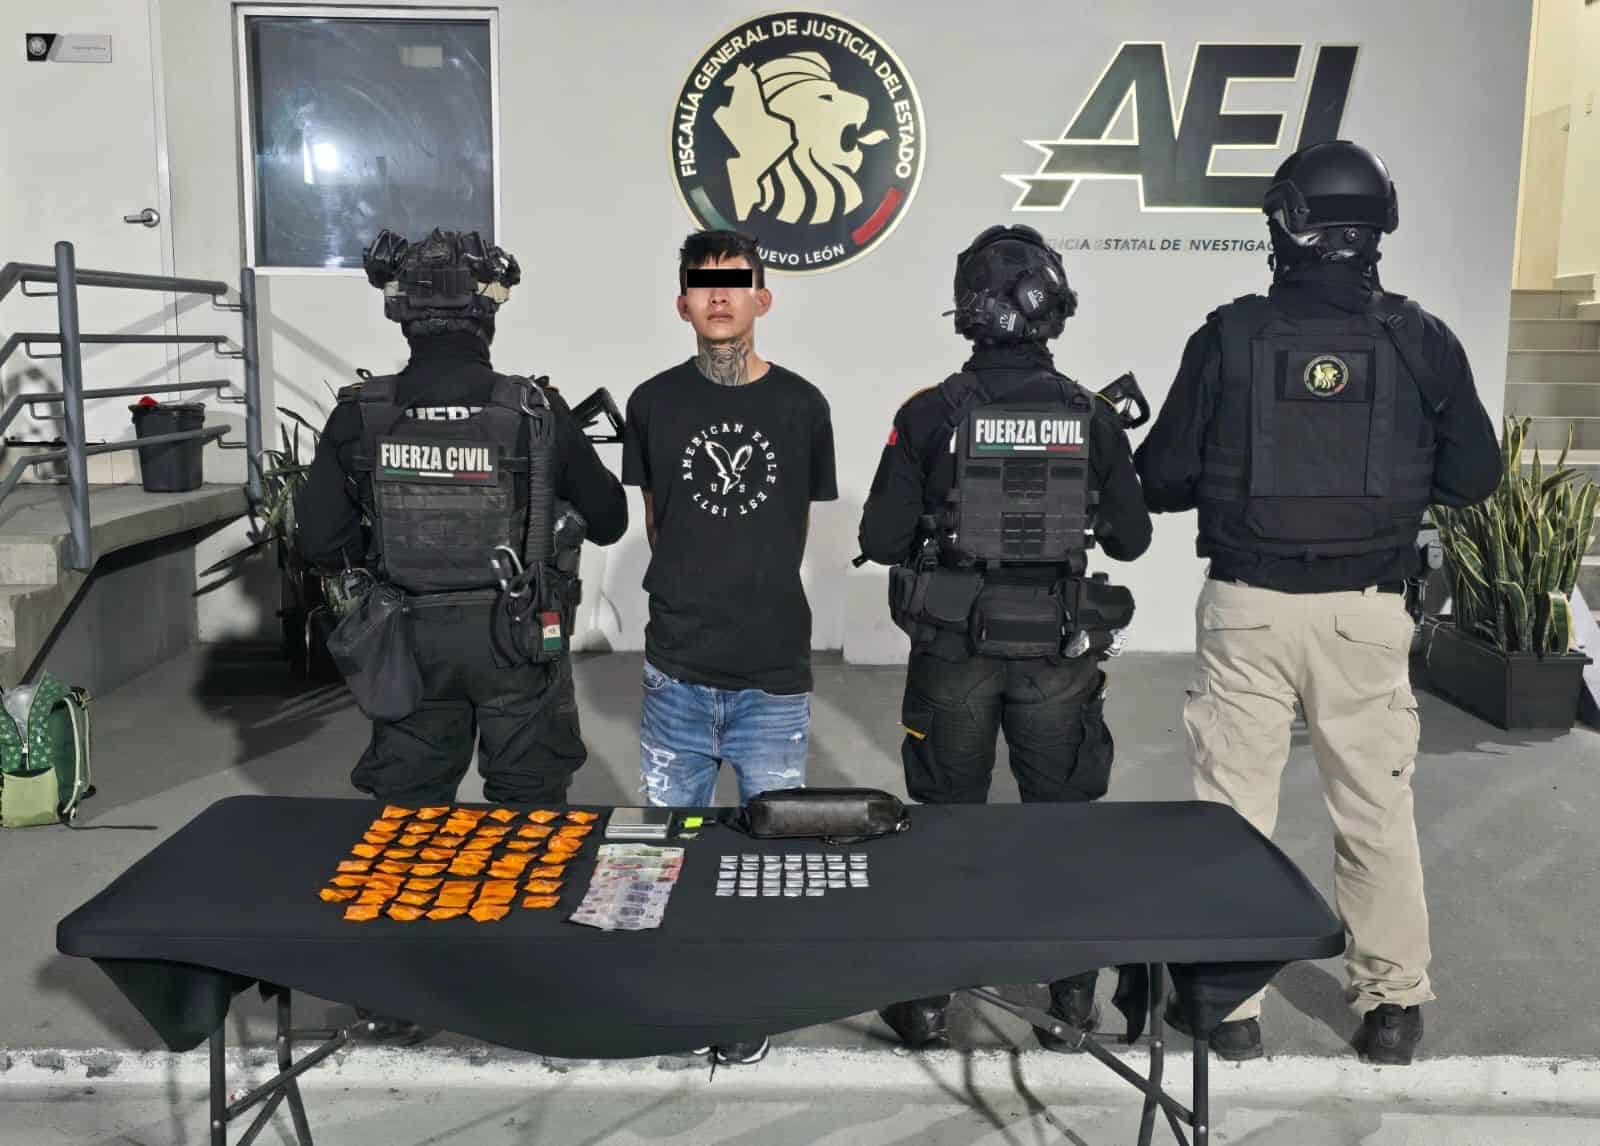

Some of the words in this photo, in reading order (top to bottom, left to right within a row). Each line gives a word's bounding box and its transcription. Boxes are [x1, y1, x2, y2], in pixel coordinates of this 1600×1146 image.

[677, 92, 703, 177] FISCALÍA
[694, 25, 769, 91] GENERAL
[772, 19, 798, 38] DE
[801, 19, 876, 67] JUSTICIA
[874, 62, 898, 100] DEL
[893, 99, 915, 179] ESTADO
[1000, 41, 1361, 213] AEI
[804, 243, 845, 264] LEÓN
[1159, 238, 1181, 251] DE
[975, 418, 1037, 444] FUERZA
[1040, 419, 1084, 445] CIVIL
[380, 443, 443, 470] FUERZA
[446, 446, 493, 472] CIVIL
[682, 423, 744, 480] AMERICAN
[752, 431, 777, 484] EAGLE
[692, 491, 727, 517] 1977
[739, 491, 768, 515] EST
